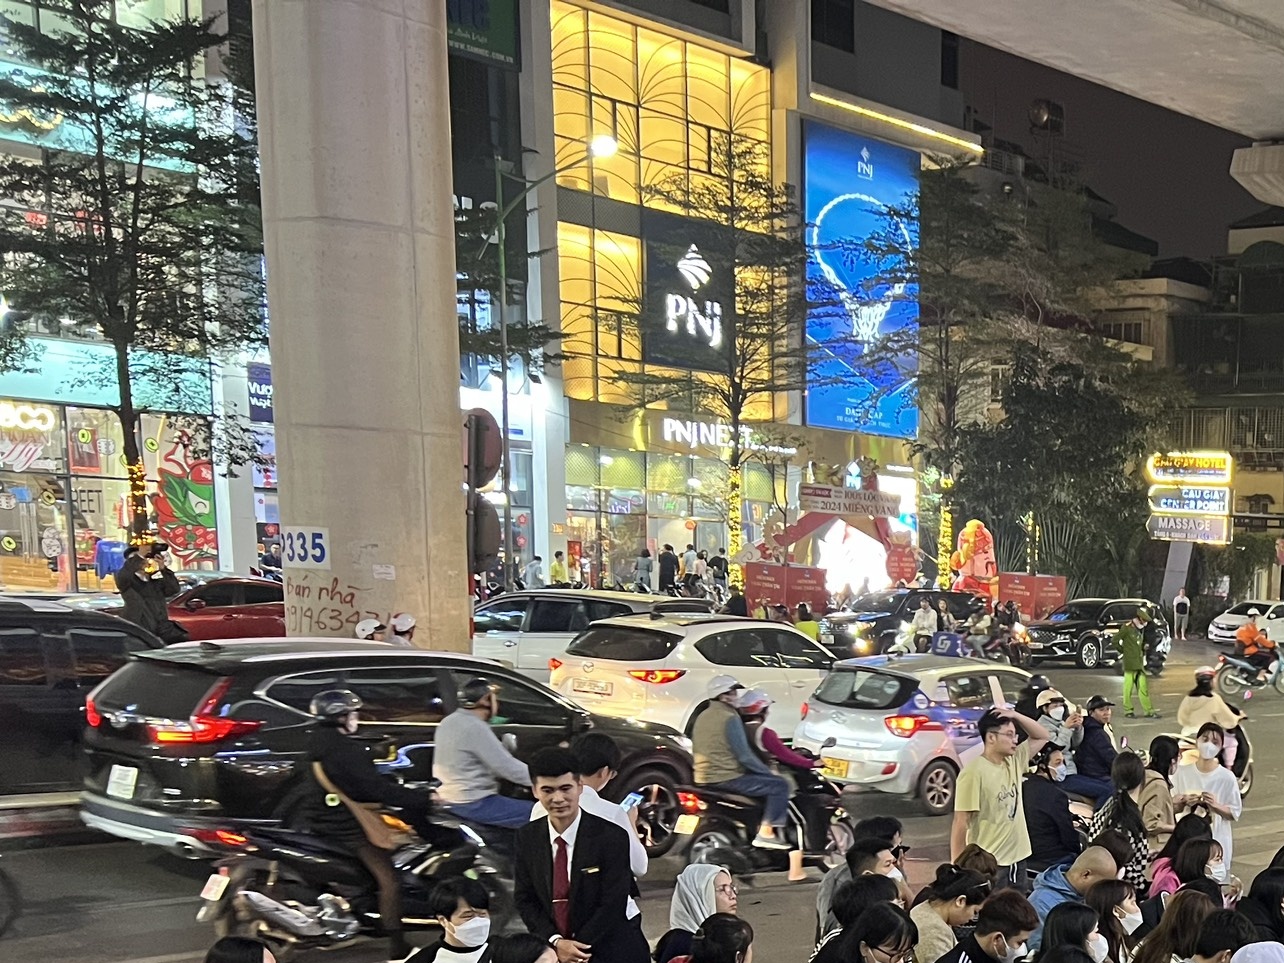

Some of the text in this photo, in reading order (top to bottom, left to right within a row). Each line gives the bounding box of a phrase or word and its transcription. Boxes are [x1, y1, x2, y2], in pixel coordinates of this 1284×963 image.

[665, 293, 723, 348] PNJ
[663, 418, 698, 449] PNJ
[1196, 457, 1226, 468] HOTEL
[820, 500, 841, 512] 2024
[1197, 501, 1225, 512] POINT
[1158, 517, 1211, 531] MASSAGE
[281, 532, 326, 563] 335
